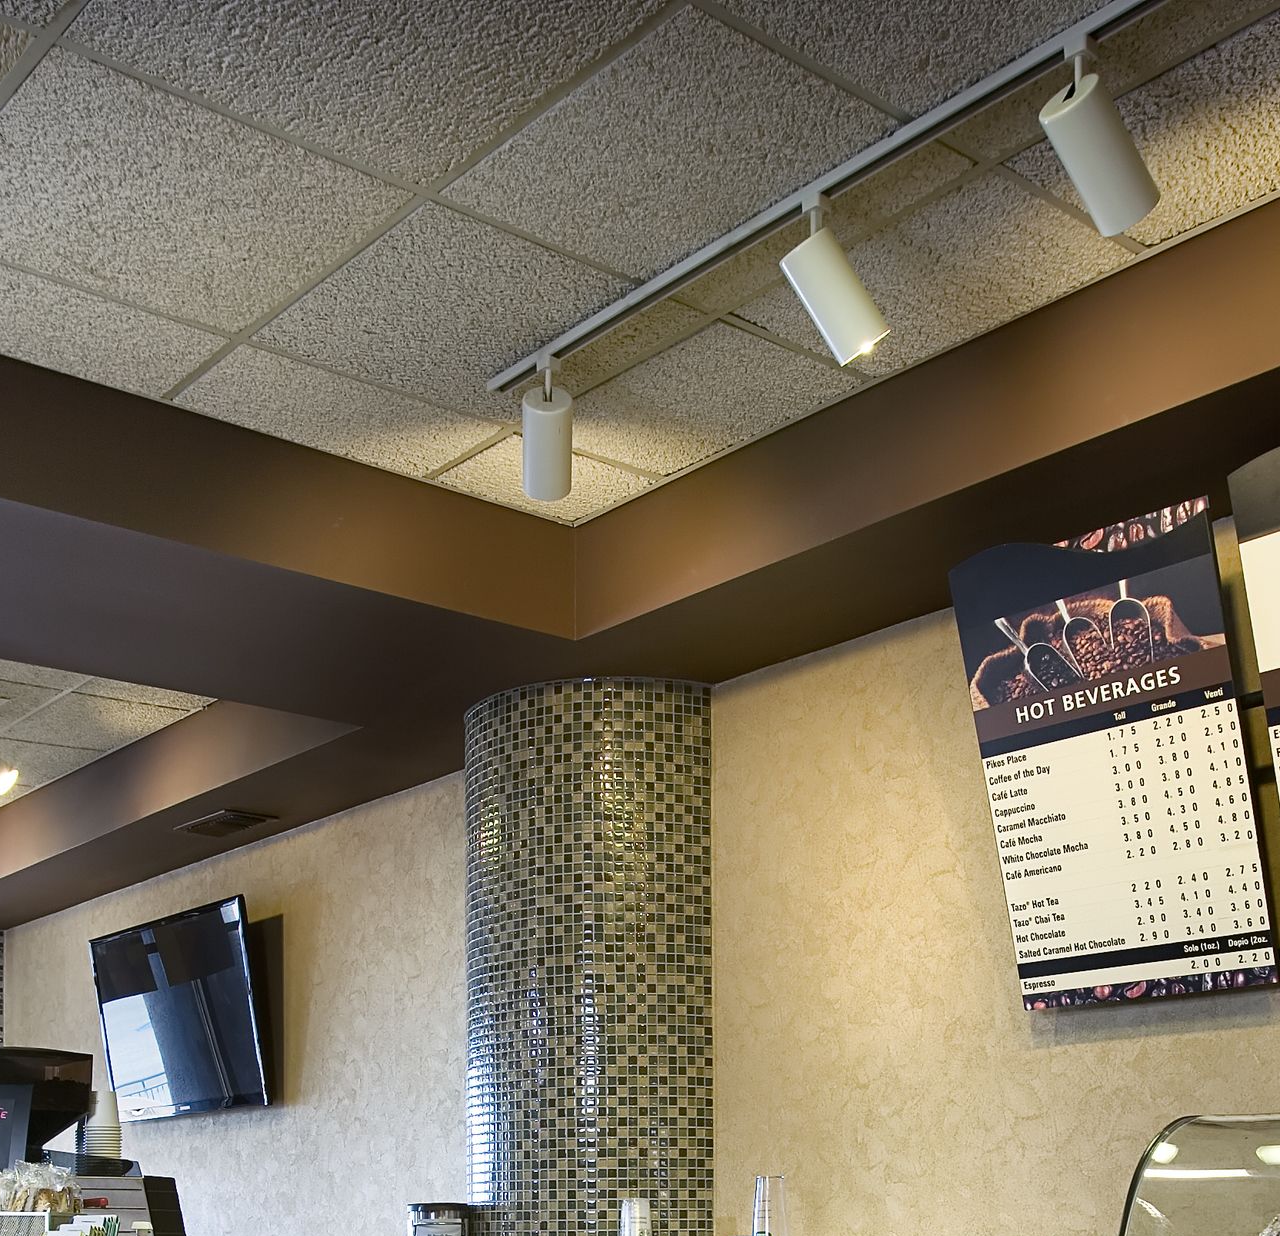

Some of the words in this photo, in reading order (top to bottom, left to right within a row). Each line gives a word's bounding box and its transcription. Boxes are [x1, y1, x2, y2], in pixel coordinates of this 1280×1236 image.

[1015, 698, 1056, 723] HOT
[1062, 666, 1181, 711] BEVERAGES
[1151, 699, 1176, 712] Grande
[1205, 687, 1224, 699] Venti
[1006, 754, 1026, 764] Place
[989, 774, 1012, 785] Coffee
[1013, 770, 1020, 780] of
[1022, 769, 1034, 778] the
[1036, 766, 1050, 774] Day
[991, 790, 1008, 801] Café
[1009, 788, 1027, 798] Latte
[994, 803, 1035, 817] Cappuccino
[997, 819, 1026, 833] Caramel
[1027, 813, 1066, 827] Macchiato
[1000, 838, 1016, 848] Café
[1017, 834, 1042, 845] Mocha
[1025, 848, 1061, 860] Chocolate
[1062, 842, 1088, 853] Mocha
[1005, 870, 1022, 880] Café
[1024, 864, 1062, 877] Americano
[1032, 900, 1044, 908] Hot
[1046, 897, 1059, 906] Tea
[1034, 914, 1050, 924] Chai
[1051, 913, 1065, 921] Tea
[1016, 934, 1028, 943] Hot
[1030, 929, 1065, 941] Chocolate
[1018, 948, 1041, 958] Salted
[1042, 943, 1072, 955] Caramel
[1074, 942, 1087, 951] Hot
[1088, 937, 1125, 949] Chocolate
[1023, 980, 1055, 990] Espresso
